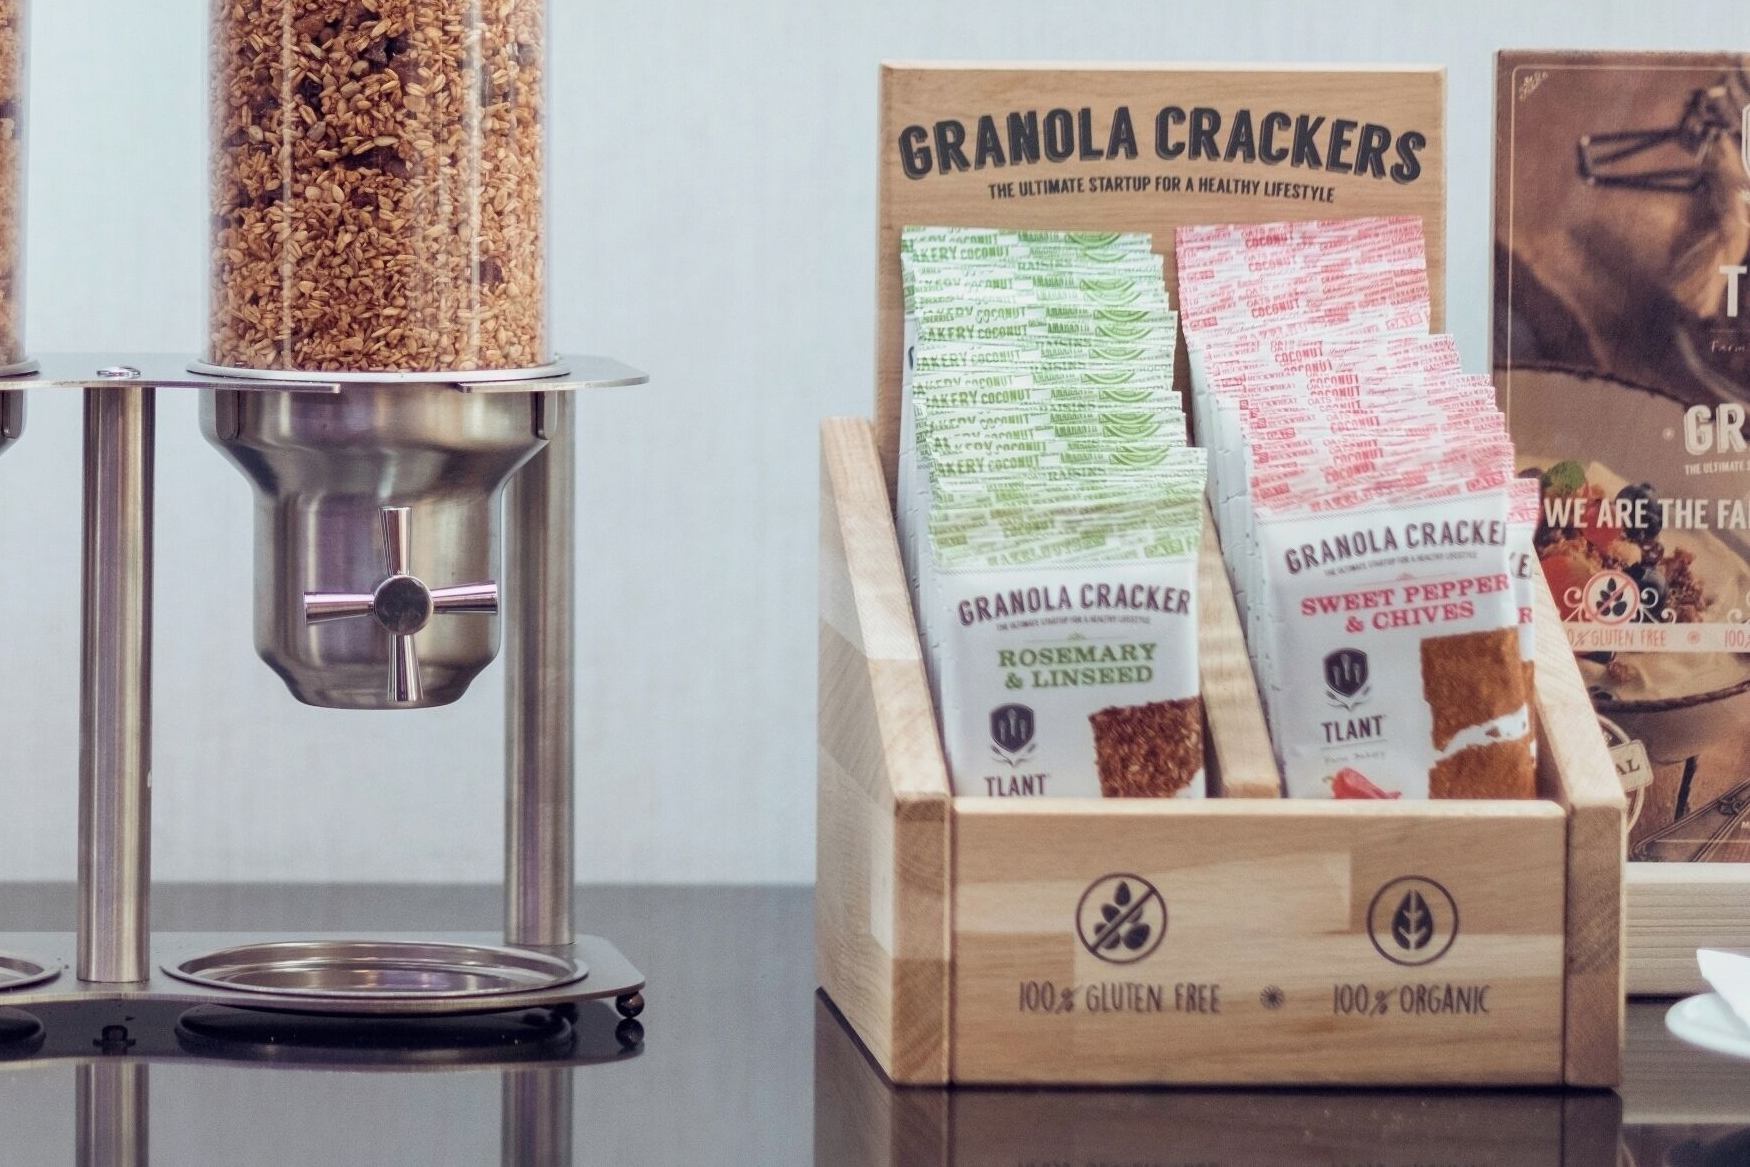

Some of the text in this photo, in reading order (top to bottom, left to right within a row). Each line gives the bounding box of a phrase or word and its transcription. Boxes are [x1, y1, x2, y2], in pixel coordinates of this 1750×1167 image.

[898, 105, 1428, 186] GRANOLA CRACKERS
[989, 175, 1334, 204] THE ULTIMATE STARTUP FOR A HEALTHY LIFESTYLE
[1251, 298, 1300, 318] COCONUT
[1275, 347, 1323, 363] COCONUT
[981, 389, 1030, 404] COCONUT
[1466, 471, 1506, 492] OATS
[1543, 498, 1588, 529] WE
[1596, 498, 1650, 530] ARE
[1657, 498, 1710, 530] THE
[1283, 520, 1507, 575] GRANOLA CRACKE
[957, 582, 1192, 627] GRANOLA CRACKER
[1301, 572, 1510, 617] SWEET PEPPER
[1345, 600, 1476, 633] & CHIVES
[1590, 629, 1634, 646] GLUTEN
[1641, 628, 1667, 645] FREE
[997, 642, 1158, 668] ROSEMARY
[1004, 665, 1155, 690] & LINSEED
[1321, 715, 1384, 743] TLANT
[984, 774, 1048, 797] TLANT
[1018, 981, 1222, 1015] 100% GLUTEN FREE
[1333, 983, 1492, 1017] 100% ORGANIC
